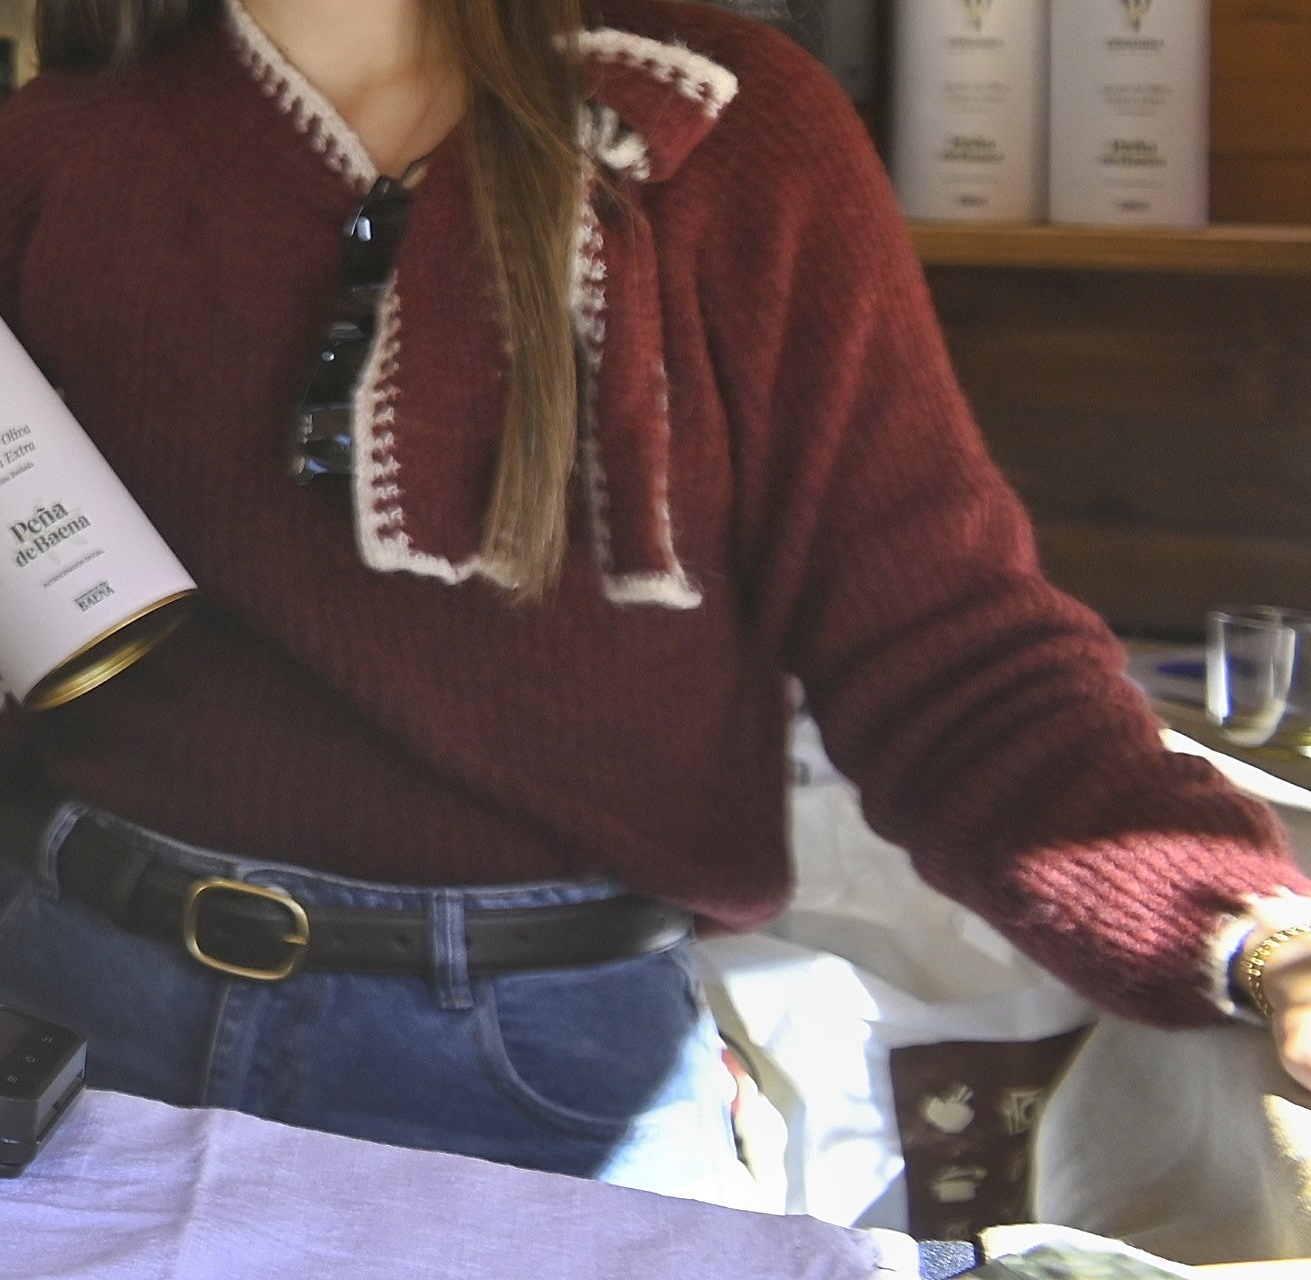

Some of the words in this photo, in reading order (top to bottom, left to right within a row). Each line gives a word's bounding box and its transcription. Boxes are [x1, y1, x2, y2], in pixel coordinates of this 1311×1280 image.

[0, 425, 32, 446] Oliva
[5, 441, 37, 465] Extra
[10, 503, 69, 543] Peña
[33, 515, 91, 554] Baena
[78, 584, 115, 612] BAENA
